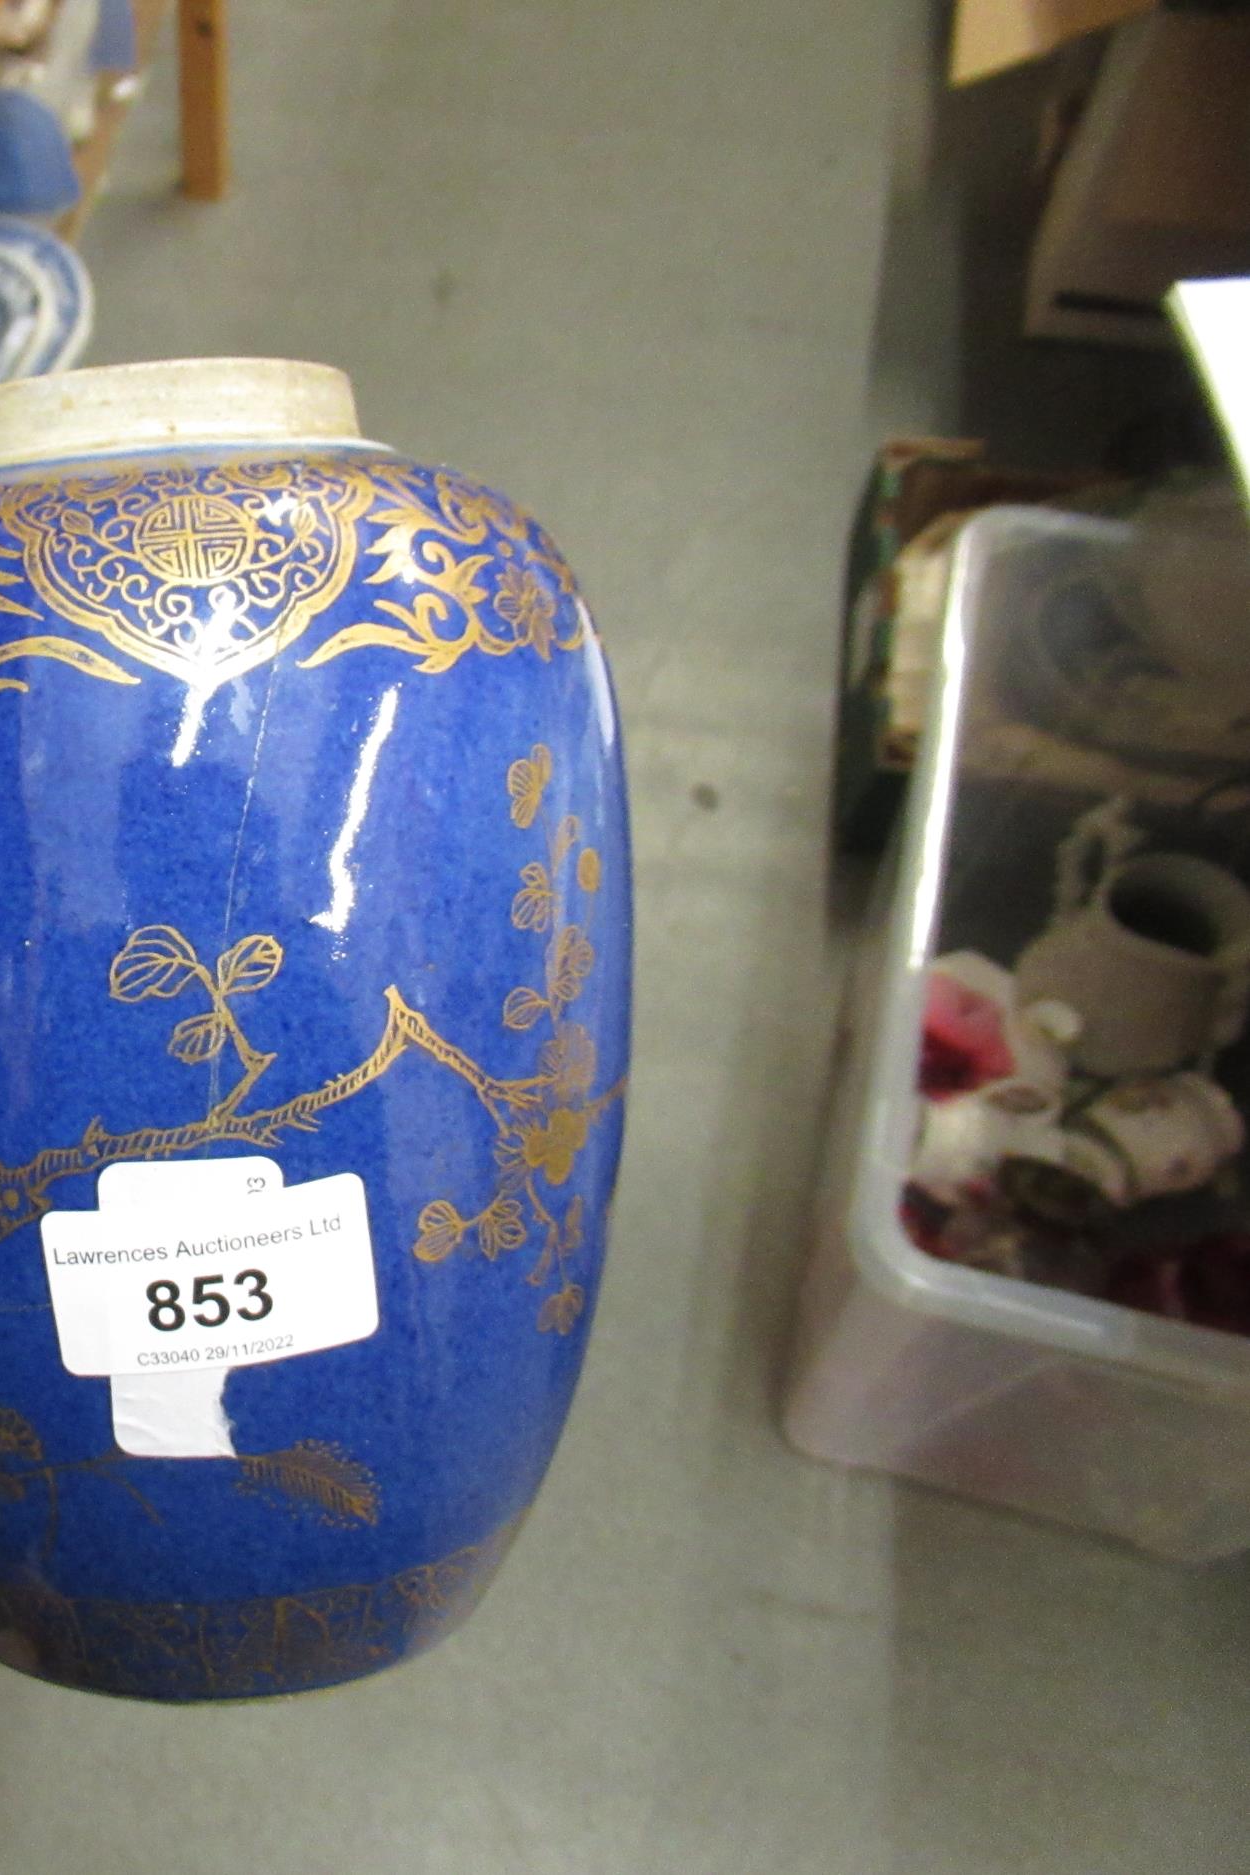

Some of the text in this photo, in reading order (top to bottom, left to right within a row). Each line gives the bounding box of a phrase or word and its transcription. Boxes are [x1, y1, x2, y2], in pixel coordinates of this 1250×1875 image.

[53, 1213, 341, 1265] Lawrences Auctioneers Ltd
[146, 1268, 274, 1332] 853
[137, 1334, 294, 1367] C33040 29/11/2022
